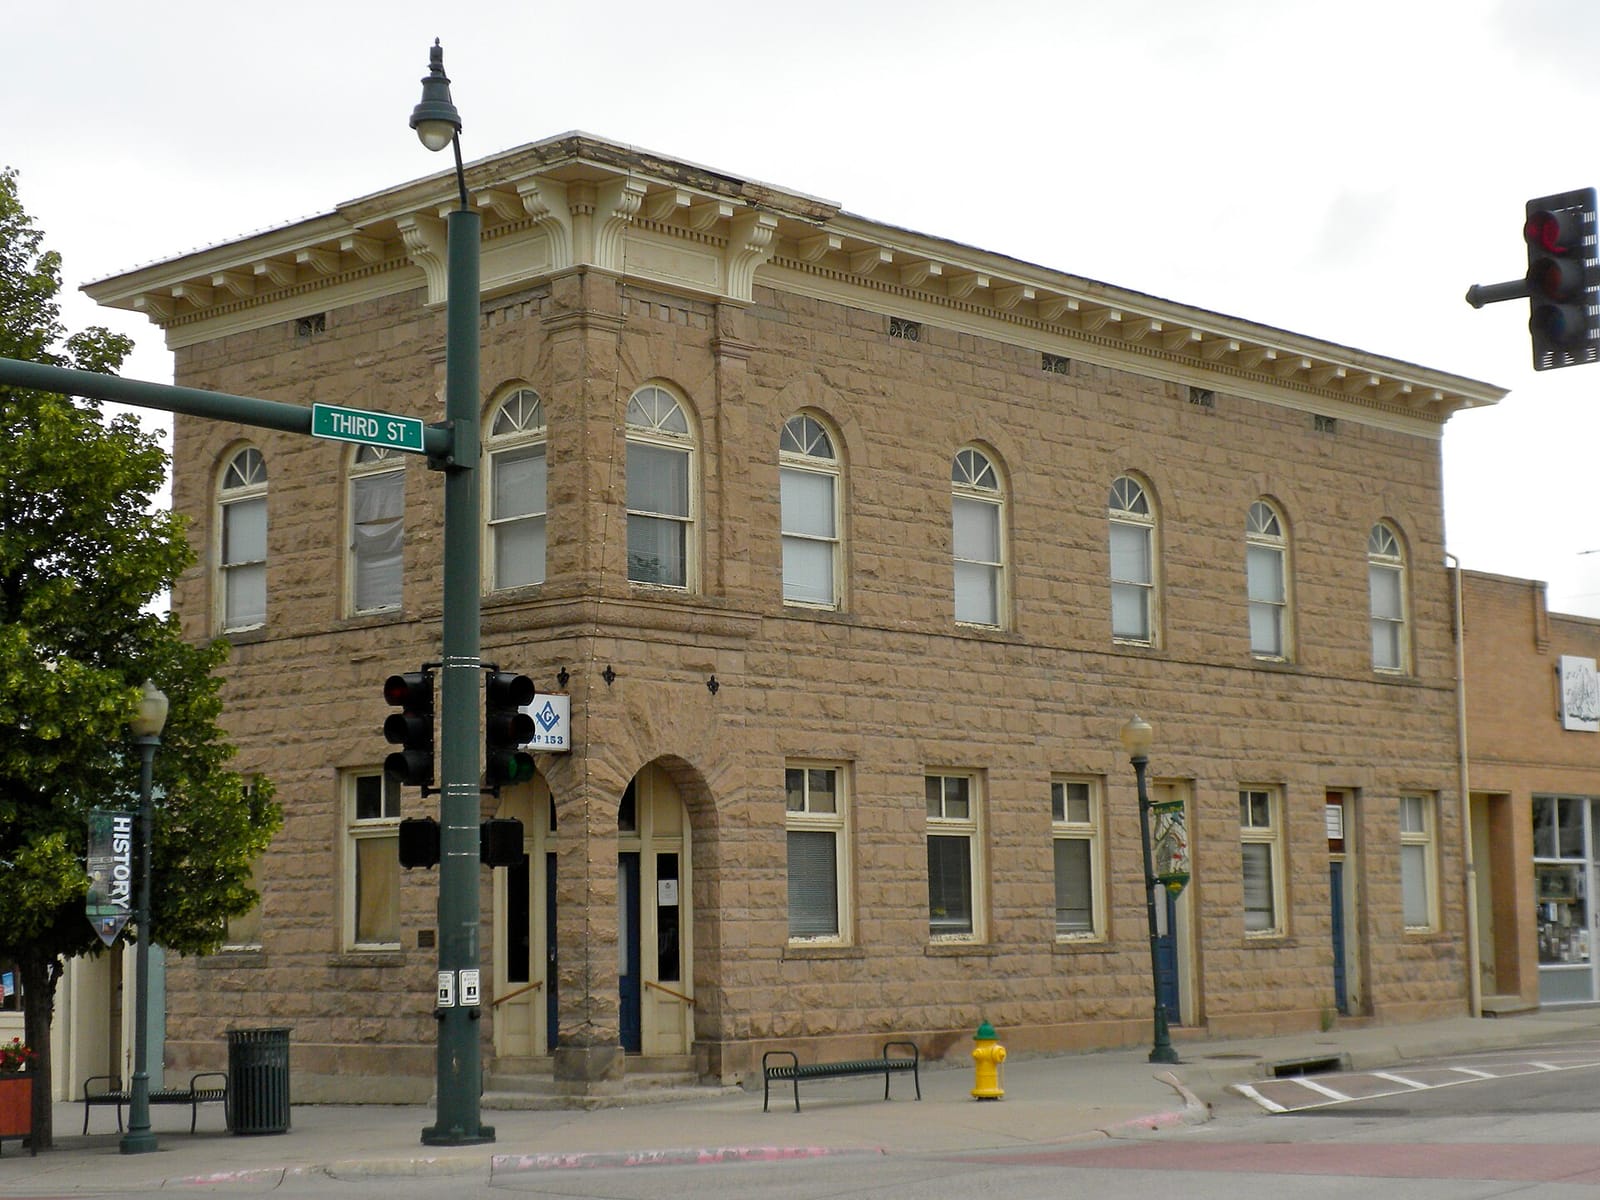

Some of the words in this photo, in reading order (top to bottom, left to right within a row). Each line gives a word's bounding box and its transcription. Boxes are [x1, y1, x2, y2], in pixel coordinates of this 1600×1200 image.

[330, 413, 379, 437] THIRD
[387, 422, 407, 442] ST
[544, 735, 564, 745] 153
[111, 817, 131, 910] HISTORY
